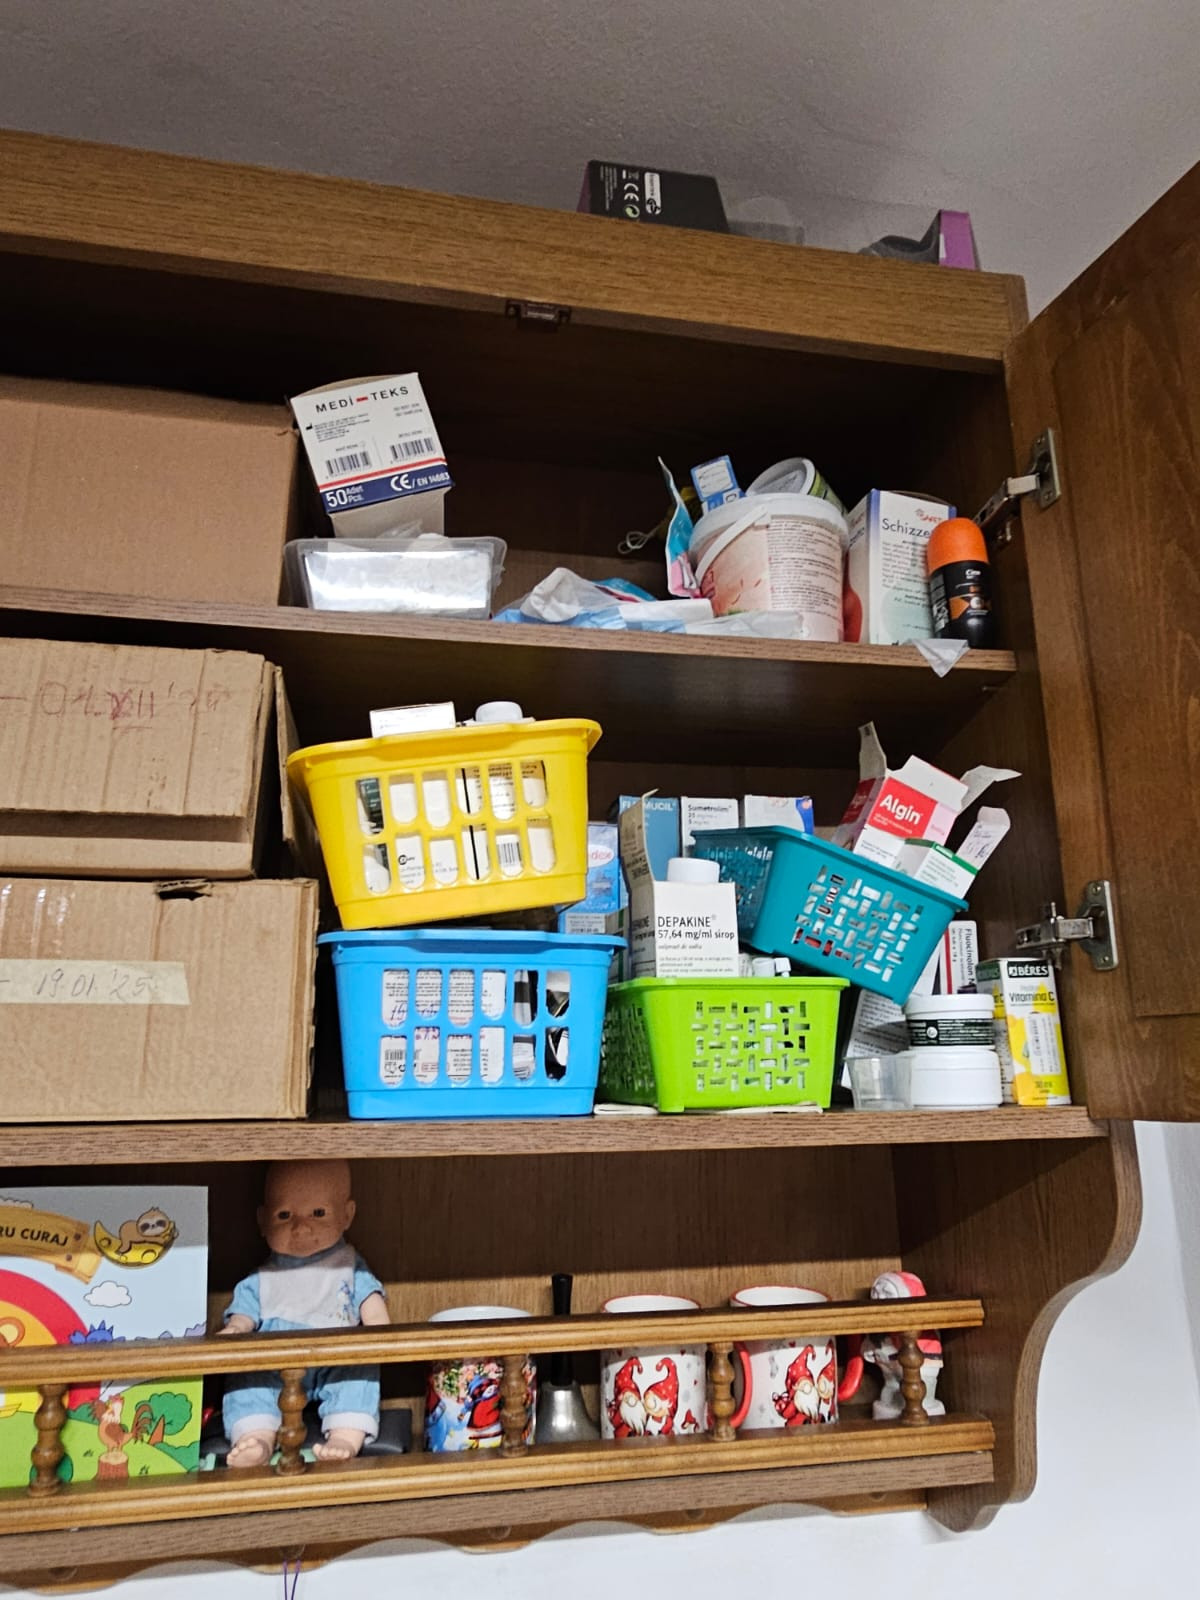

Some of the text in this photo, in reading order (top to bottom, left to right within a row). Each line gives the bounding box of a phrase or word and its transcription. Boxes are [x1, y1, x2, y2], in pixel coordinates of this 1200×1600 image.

[326, 489, 348, 508] 50
[882, 518, 931, 539] Schizze
[880, 794, 921, 825] Algin
[657, 916, 711, 928] DEPAKINE
[658, 929, 735, 940] 57,64 mg/ml sirop
[1019, 964, 1048, 976] BÉRES
[1009, 991, 1055, 1002] Vitamina C
[20, 1228, 68, 1246] CURAJ
